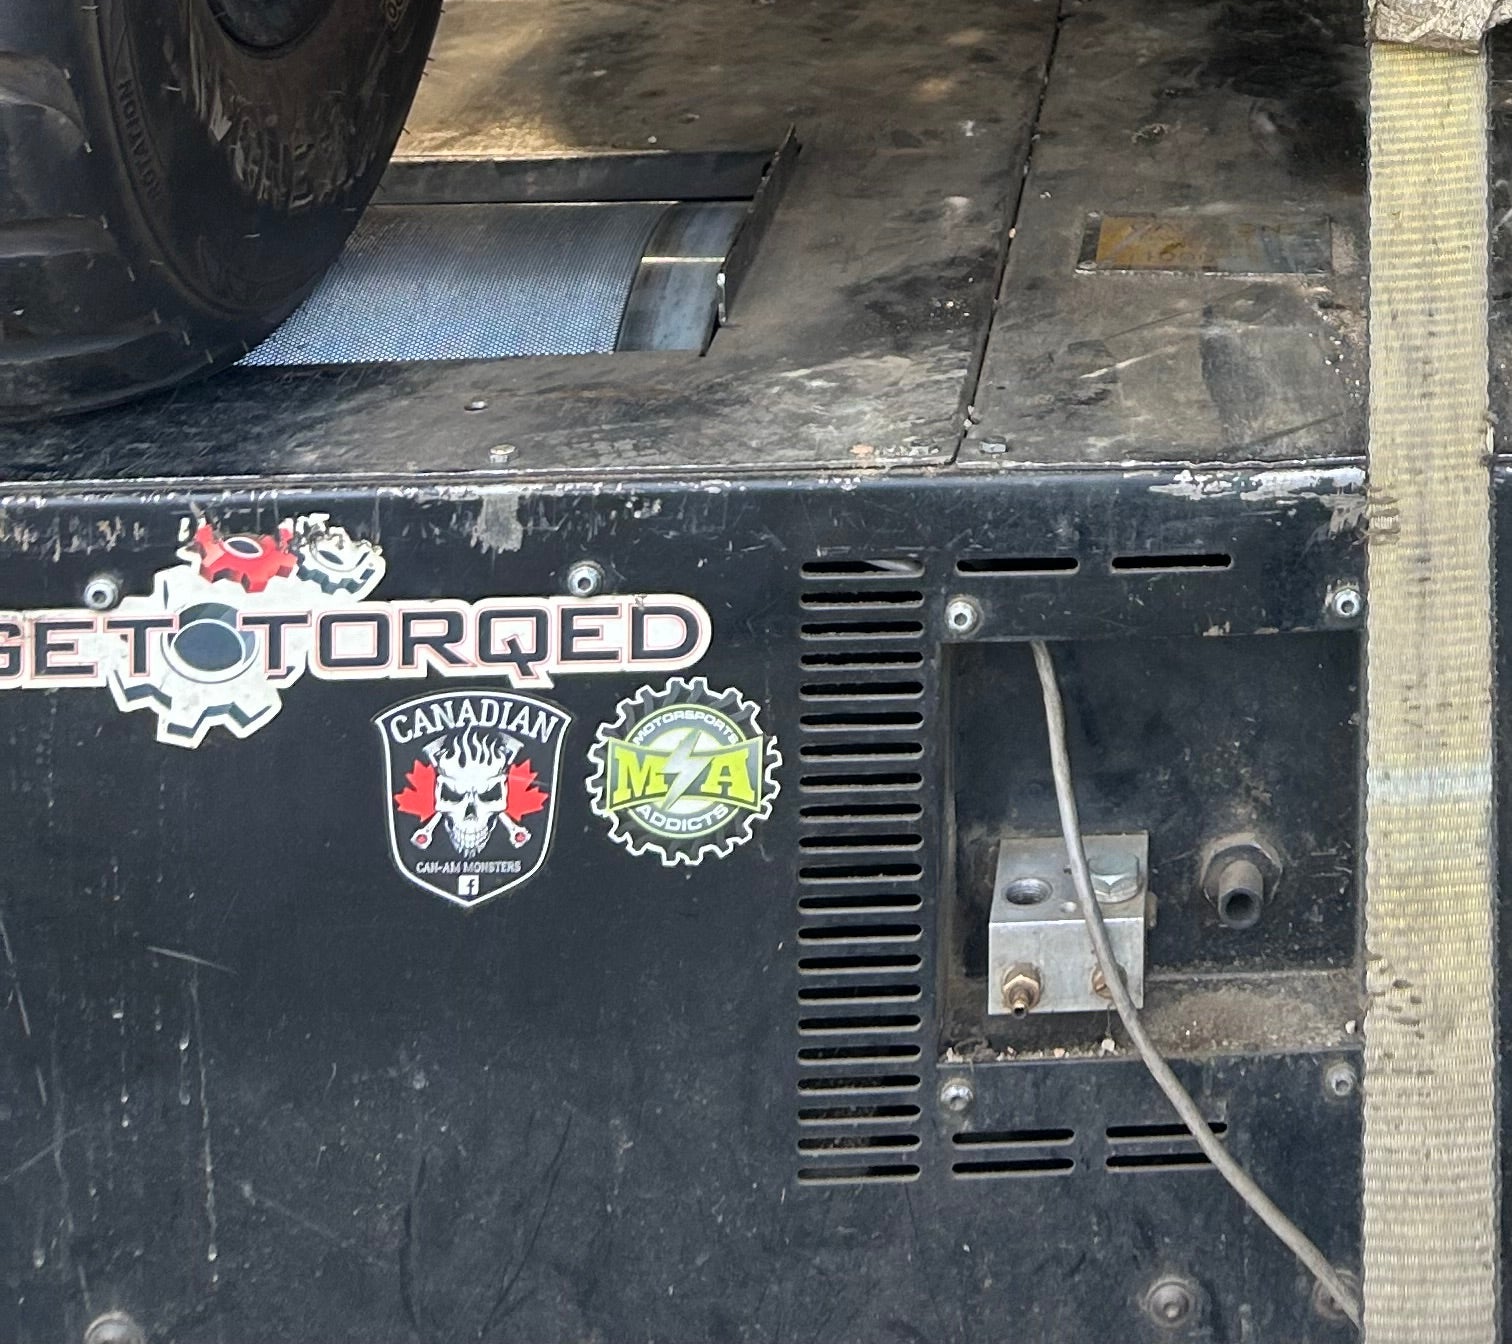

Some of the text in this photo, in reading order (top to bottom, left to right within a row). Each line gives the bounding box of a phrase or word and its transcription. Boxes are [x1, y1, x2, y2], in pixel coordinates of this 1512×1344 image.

[242, 605, 703, 676] TORQED
[389, 698, 559, 744] CANADIAN
[633, 709, 739, 746] MOTORSPORTS
[635, 802, 729, 832] ADDICTS
[415, 860, 522, 874] CAN-AM MONSTERS
